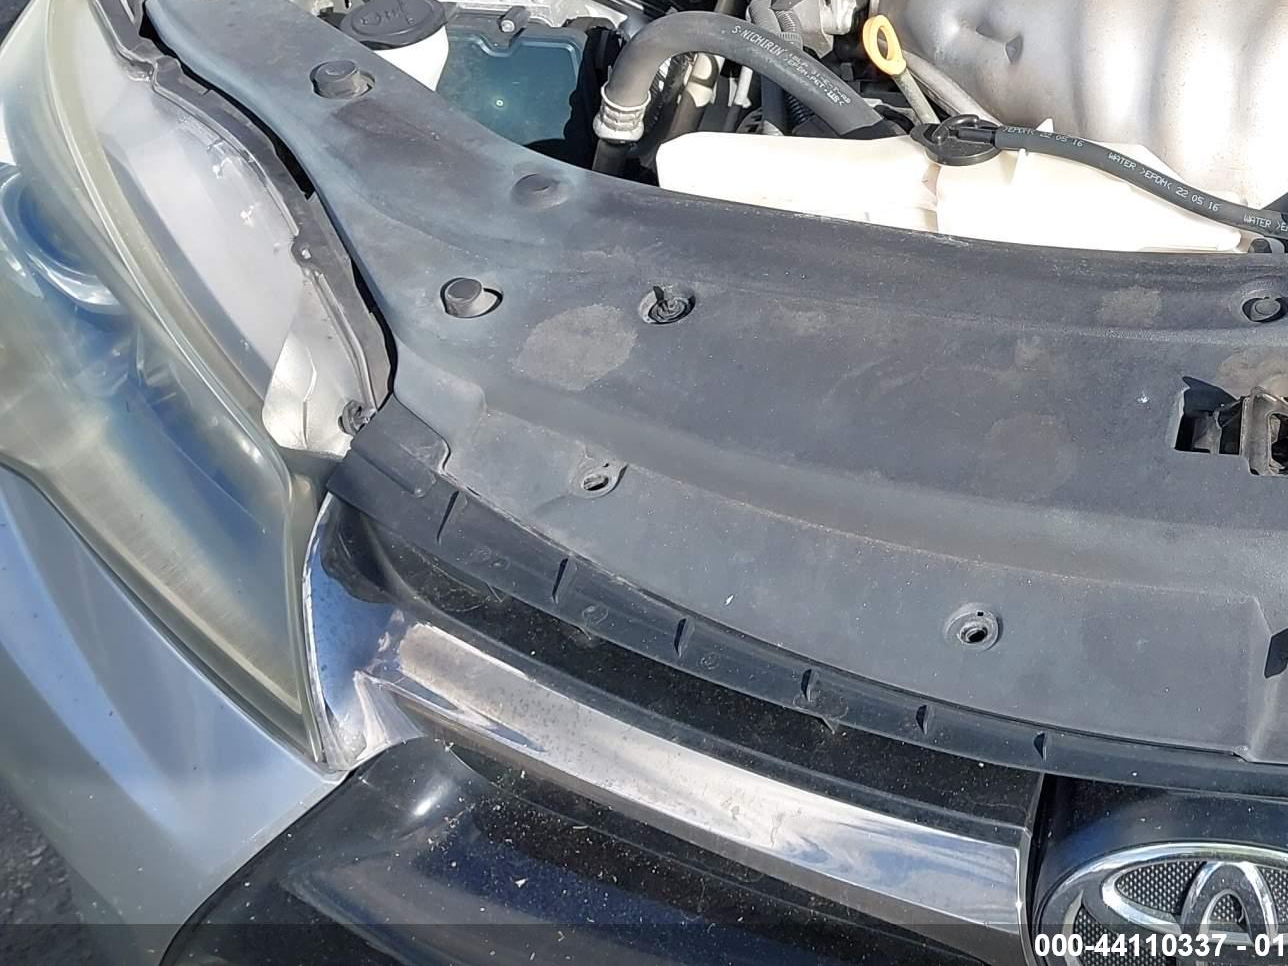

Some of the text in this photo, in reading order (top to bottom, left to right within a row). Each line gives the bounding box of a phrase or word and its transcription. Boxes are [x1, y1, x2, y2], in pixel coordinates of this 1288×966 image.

[1109, 152, 1136, 171] WATER
[1175, 186, 1188, 199] 22
[1191, 194, 1205, 206] 05
[1208, 201, 1221, 212] 16
[1243, 214, 1272, 228] WATER
